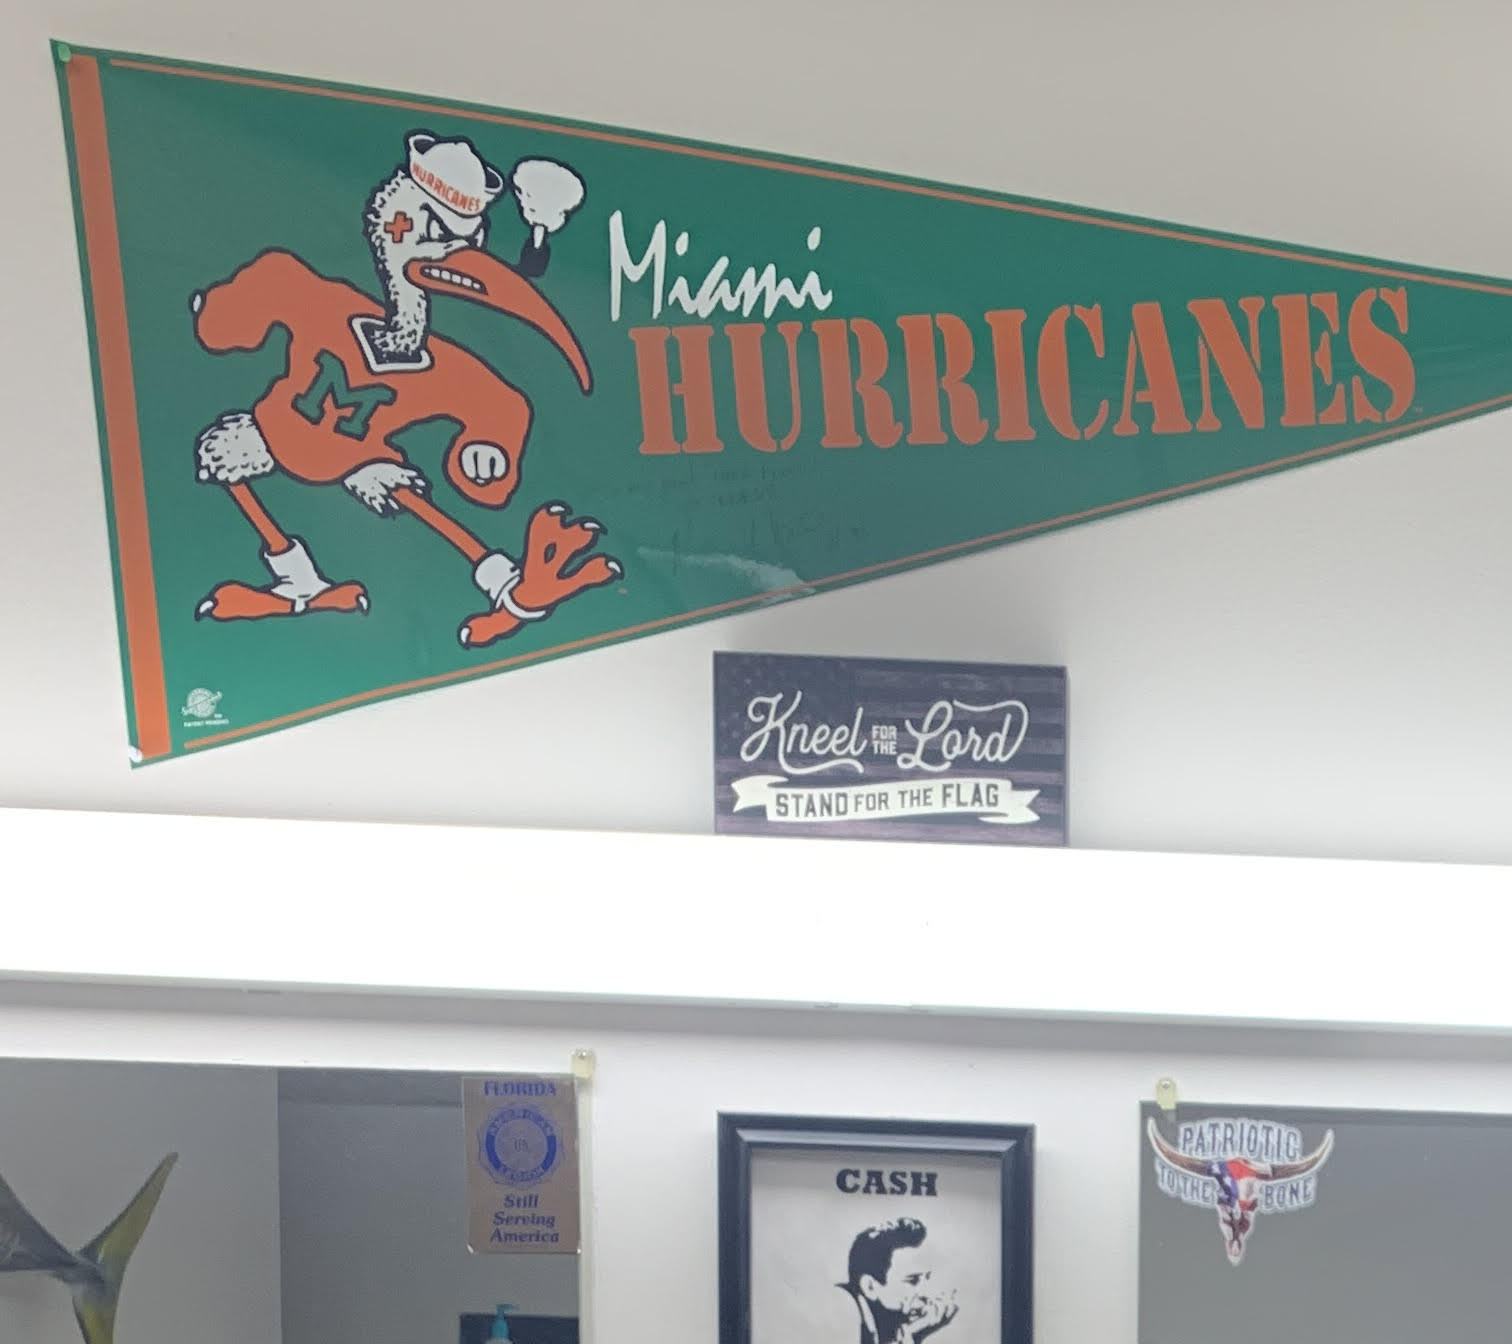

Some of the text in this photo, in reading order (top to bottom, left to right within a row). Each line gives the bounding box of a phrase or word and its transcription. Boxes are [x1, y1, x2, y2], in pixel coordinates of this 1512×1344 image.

[411, 162, 481, 212] HURRICANES
[609, 210, 833, 322] Miami
[628, 286, 1416, 455] HURRICANES
[740, 690, 1029, 775] Kneel FOR THE Lord
[775, 783, 1000, 819] STAND FOR THE FLAG
[483, 1080, 557, 1097] FLORIDA
[1181, 1122, 1298, 1161] PATRIOTIC
[836, 1167, 938, 1197] CASH
[1159, 1165, 1314, 1206] TO THE BONE
[502, 1193, 539, 1209] Still
[490, 1227, 560, 1244] America
[492, 1211, 556, 1229] Serving
